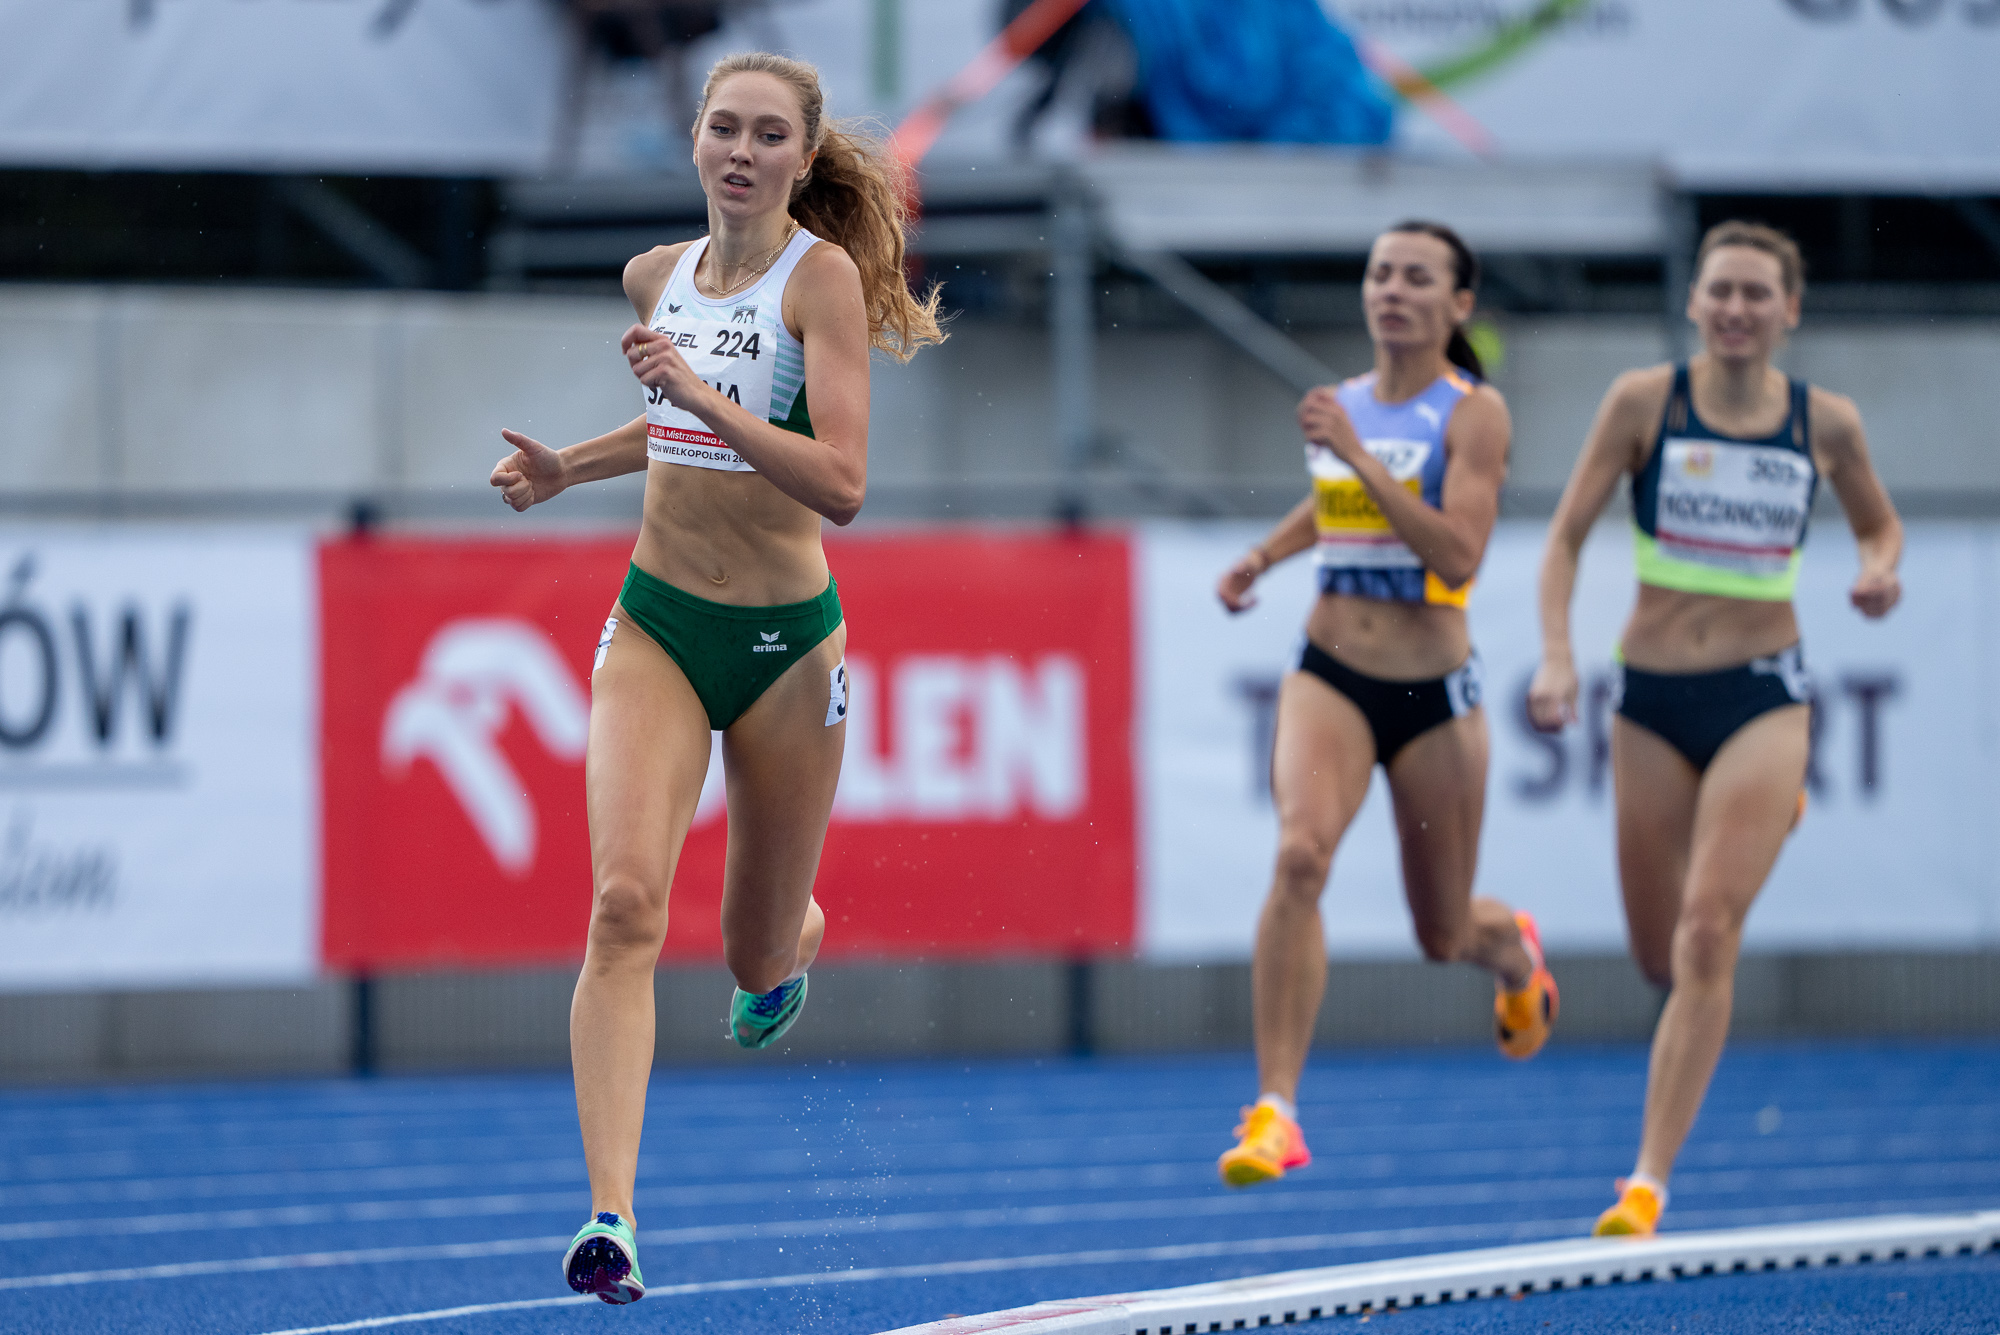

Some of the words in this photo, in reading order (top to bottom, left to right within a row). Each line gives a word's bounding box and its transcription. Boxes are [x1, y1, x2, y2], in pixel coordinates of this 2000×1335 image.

[710, 329, 760, 360] 224
[666, 430, 717, 445] Mistrzostwa
[662, 445, 731, 463] WIELKOPOLSKI
[752, 643, 788, 653] erima
